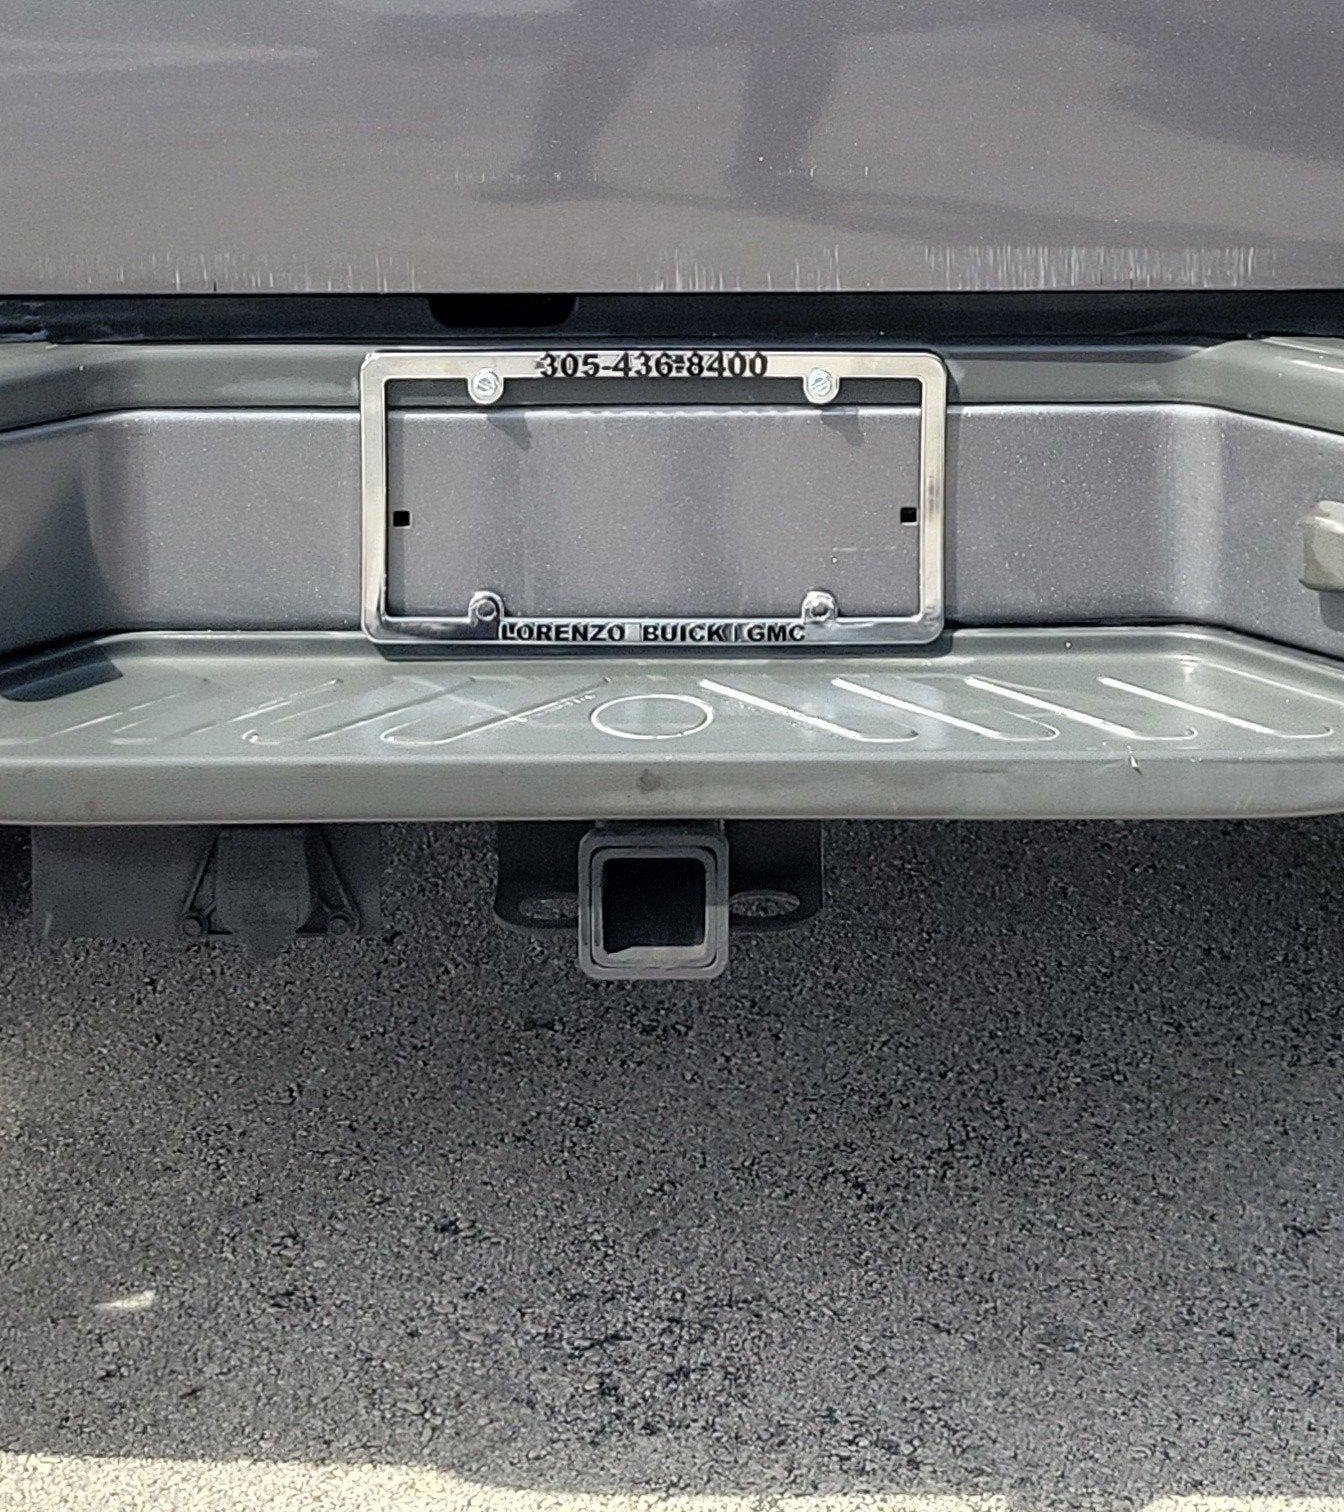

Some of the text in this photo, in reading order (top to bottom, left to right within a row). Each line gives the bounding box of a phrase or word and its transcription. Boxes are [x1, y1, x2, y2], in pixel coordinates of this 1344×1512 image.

[540, 351, 768, 378] 305-436-8400
[501, 621, 806, 642] LORENZO BUICK GMC
